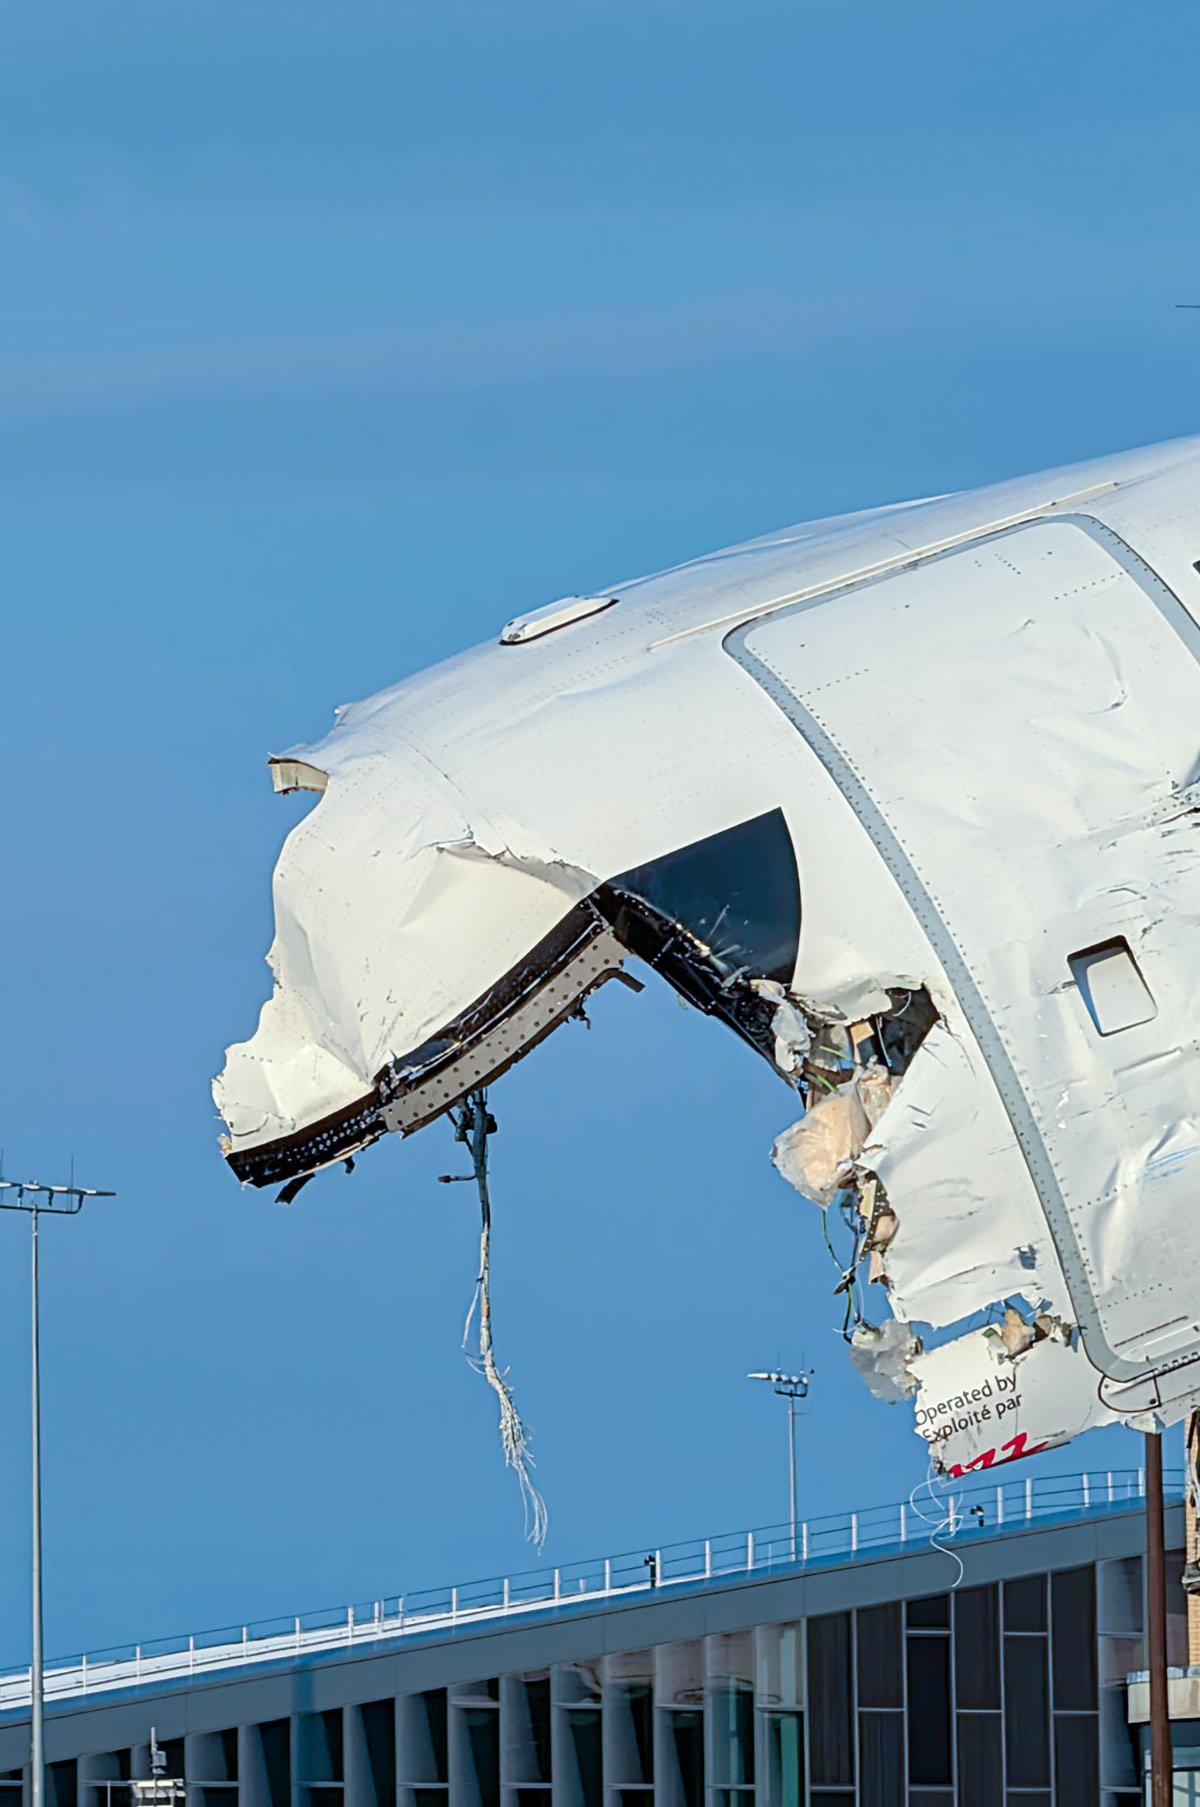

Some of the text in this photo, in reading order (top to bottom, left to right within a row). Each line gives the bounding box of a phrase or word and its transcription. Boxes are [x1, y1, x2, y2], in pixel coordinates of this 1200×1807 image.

[915, 1375, 1017, 1426] Operated by
[922, 1394, 1023, 1444] Exploité par
